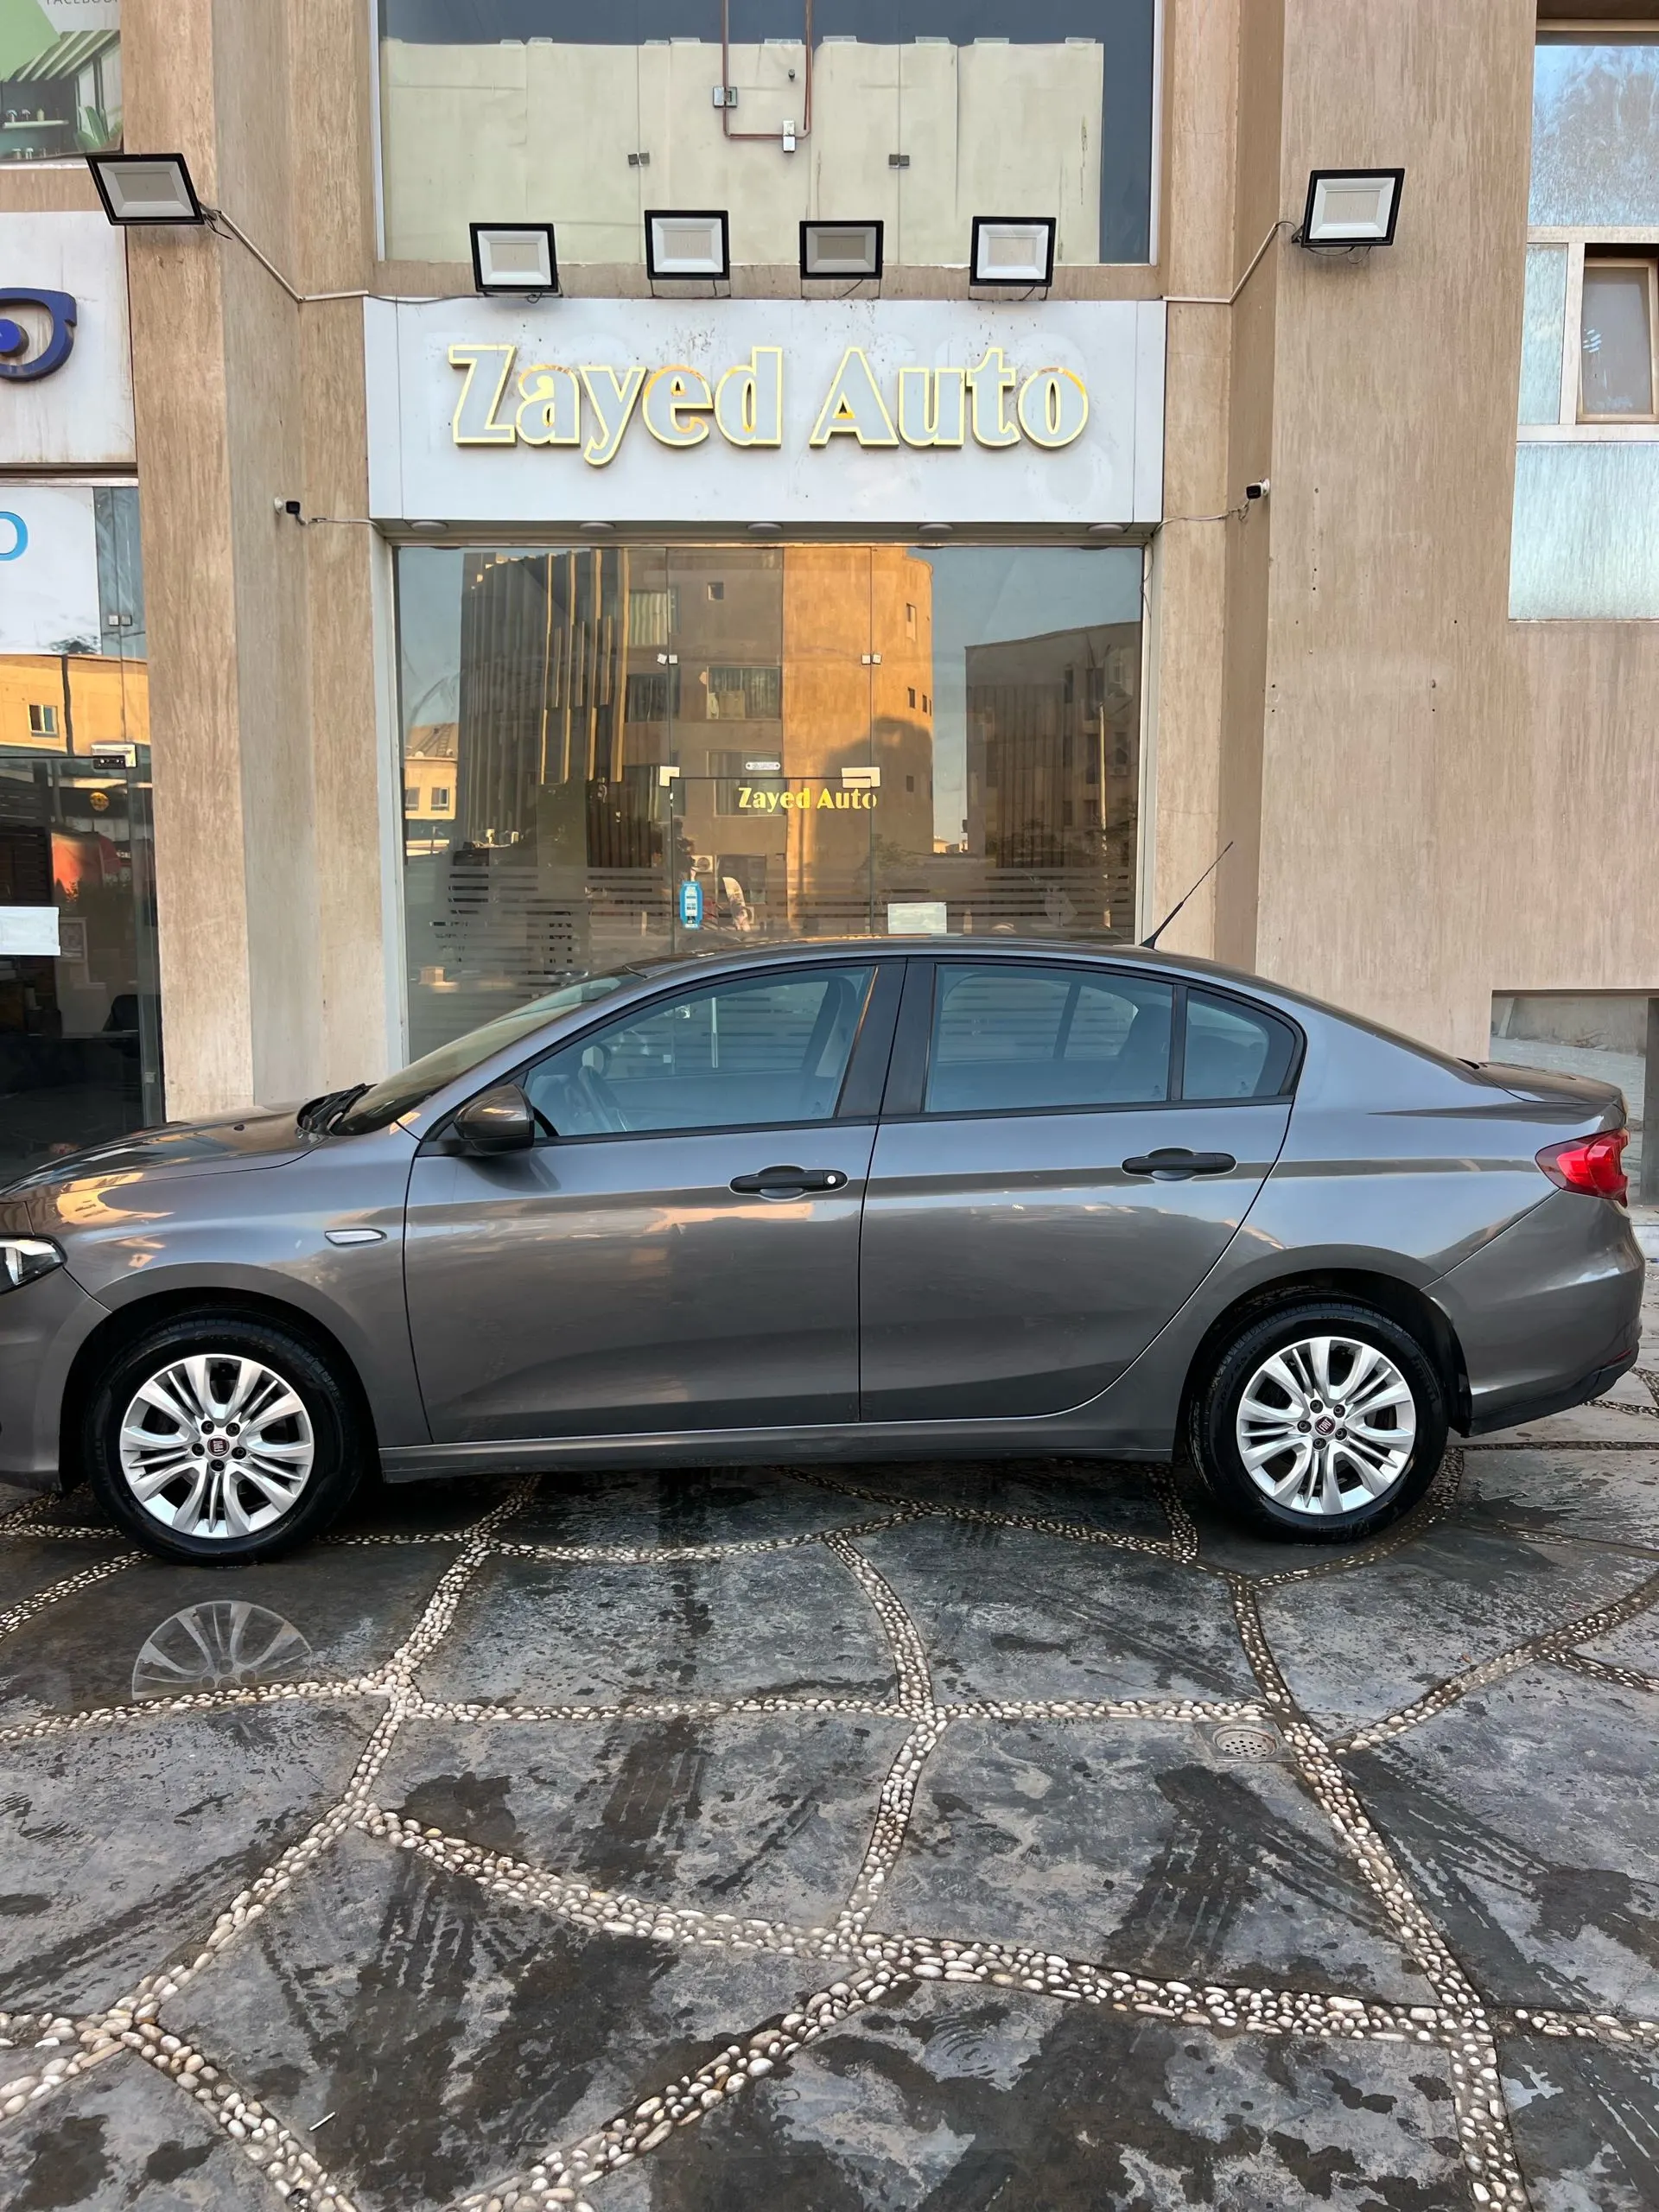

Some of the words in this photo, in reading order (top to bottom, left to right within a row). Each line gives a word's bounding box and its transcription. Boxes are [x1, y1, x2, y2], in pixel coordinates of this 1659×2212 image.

[448, 345, 785, 467] Zayed
[809, 346, 1090, 450] Auto
[738, 787, 810, 813] Zayed
[817, 787, 877, 810] Auto
[1318, 1417, 1332, 1432] FIAT
[213, 1440, 225, 1452] FIAT
